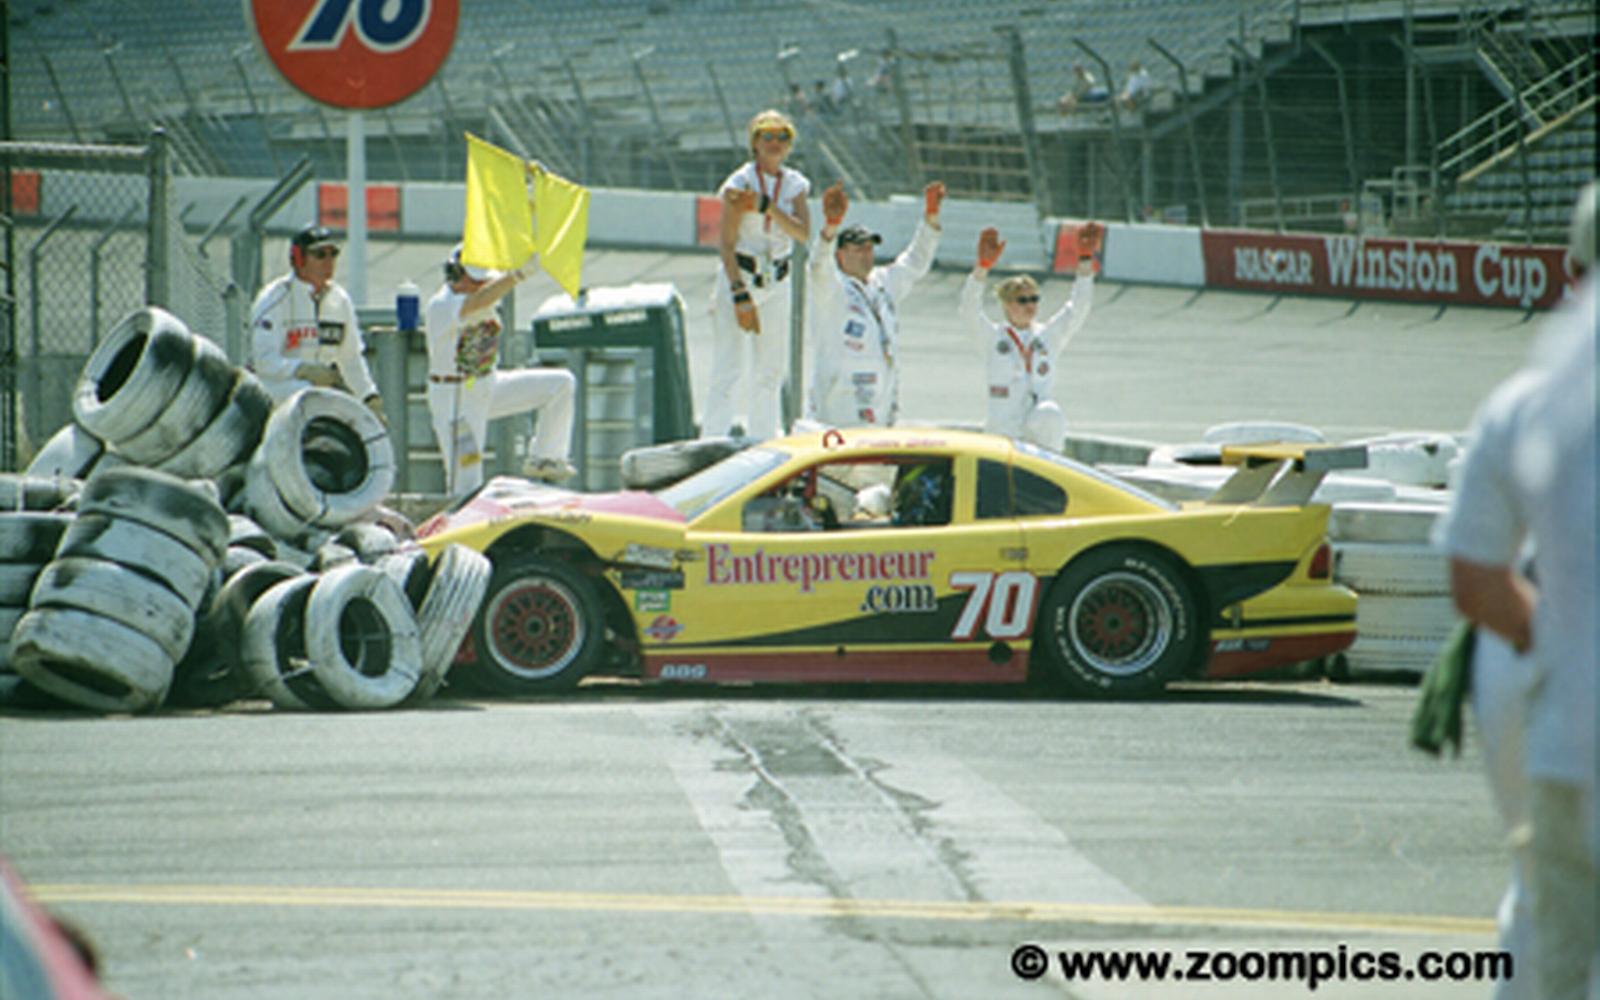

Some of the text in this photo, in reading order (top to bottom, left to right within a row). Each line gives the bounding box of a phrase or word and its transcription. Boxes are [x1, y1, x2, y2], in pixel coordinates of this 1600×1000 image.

[1235, 246, 1313, 285] NASCAR
[1325, 236, 1458, 293] Winston
[1474, 244, 1547, 308] Cup
[704, 543, 935, 592] Entrepreneur
[858, 584, 938, 613] .com
[949, 570, 1040, 640] 70
